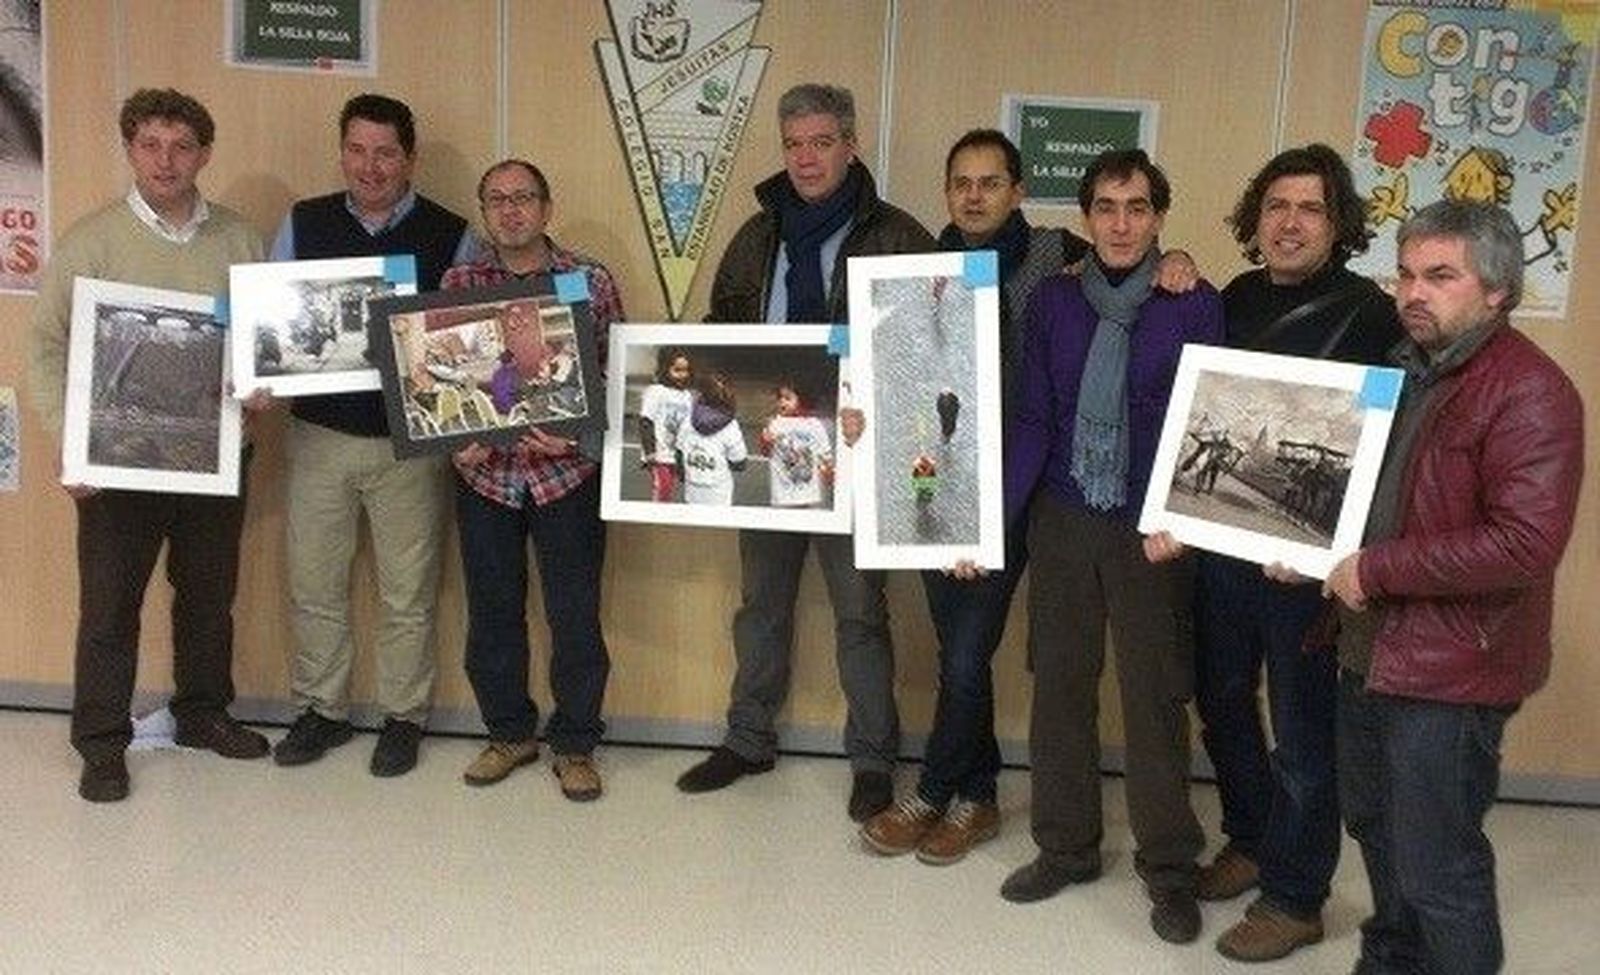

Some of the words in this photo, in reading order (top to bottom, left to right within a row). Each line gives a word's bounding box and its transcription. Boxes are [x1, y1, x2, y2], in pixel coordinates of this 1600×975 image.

[259, 26, 276, 37] LA
[278, 27, 313, 41] SILLA
[1029, 116, 1049, 128] YO
[715, 157, 729, 175] DE
[1032, 164, 1049, 177] LA
[619, 98, 655, 197] COLEGIO
[651, 218, 672, 259] SAN
